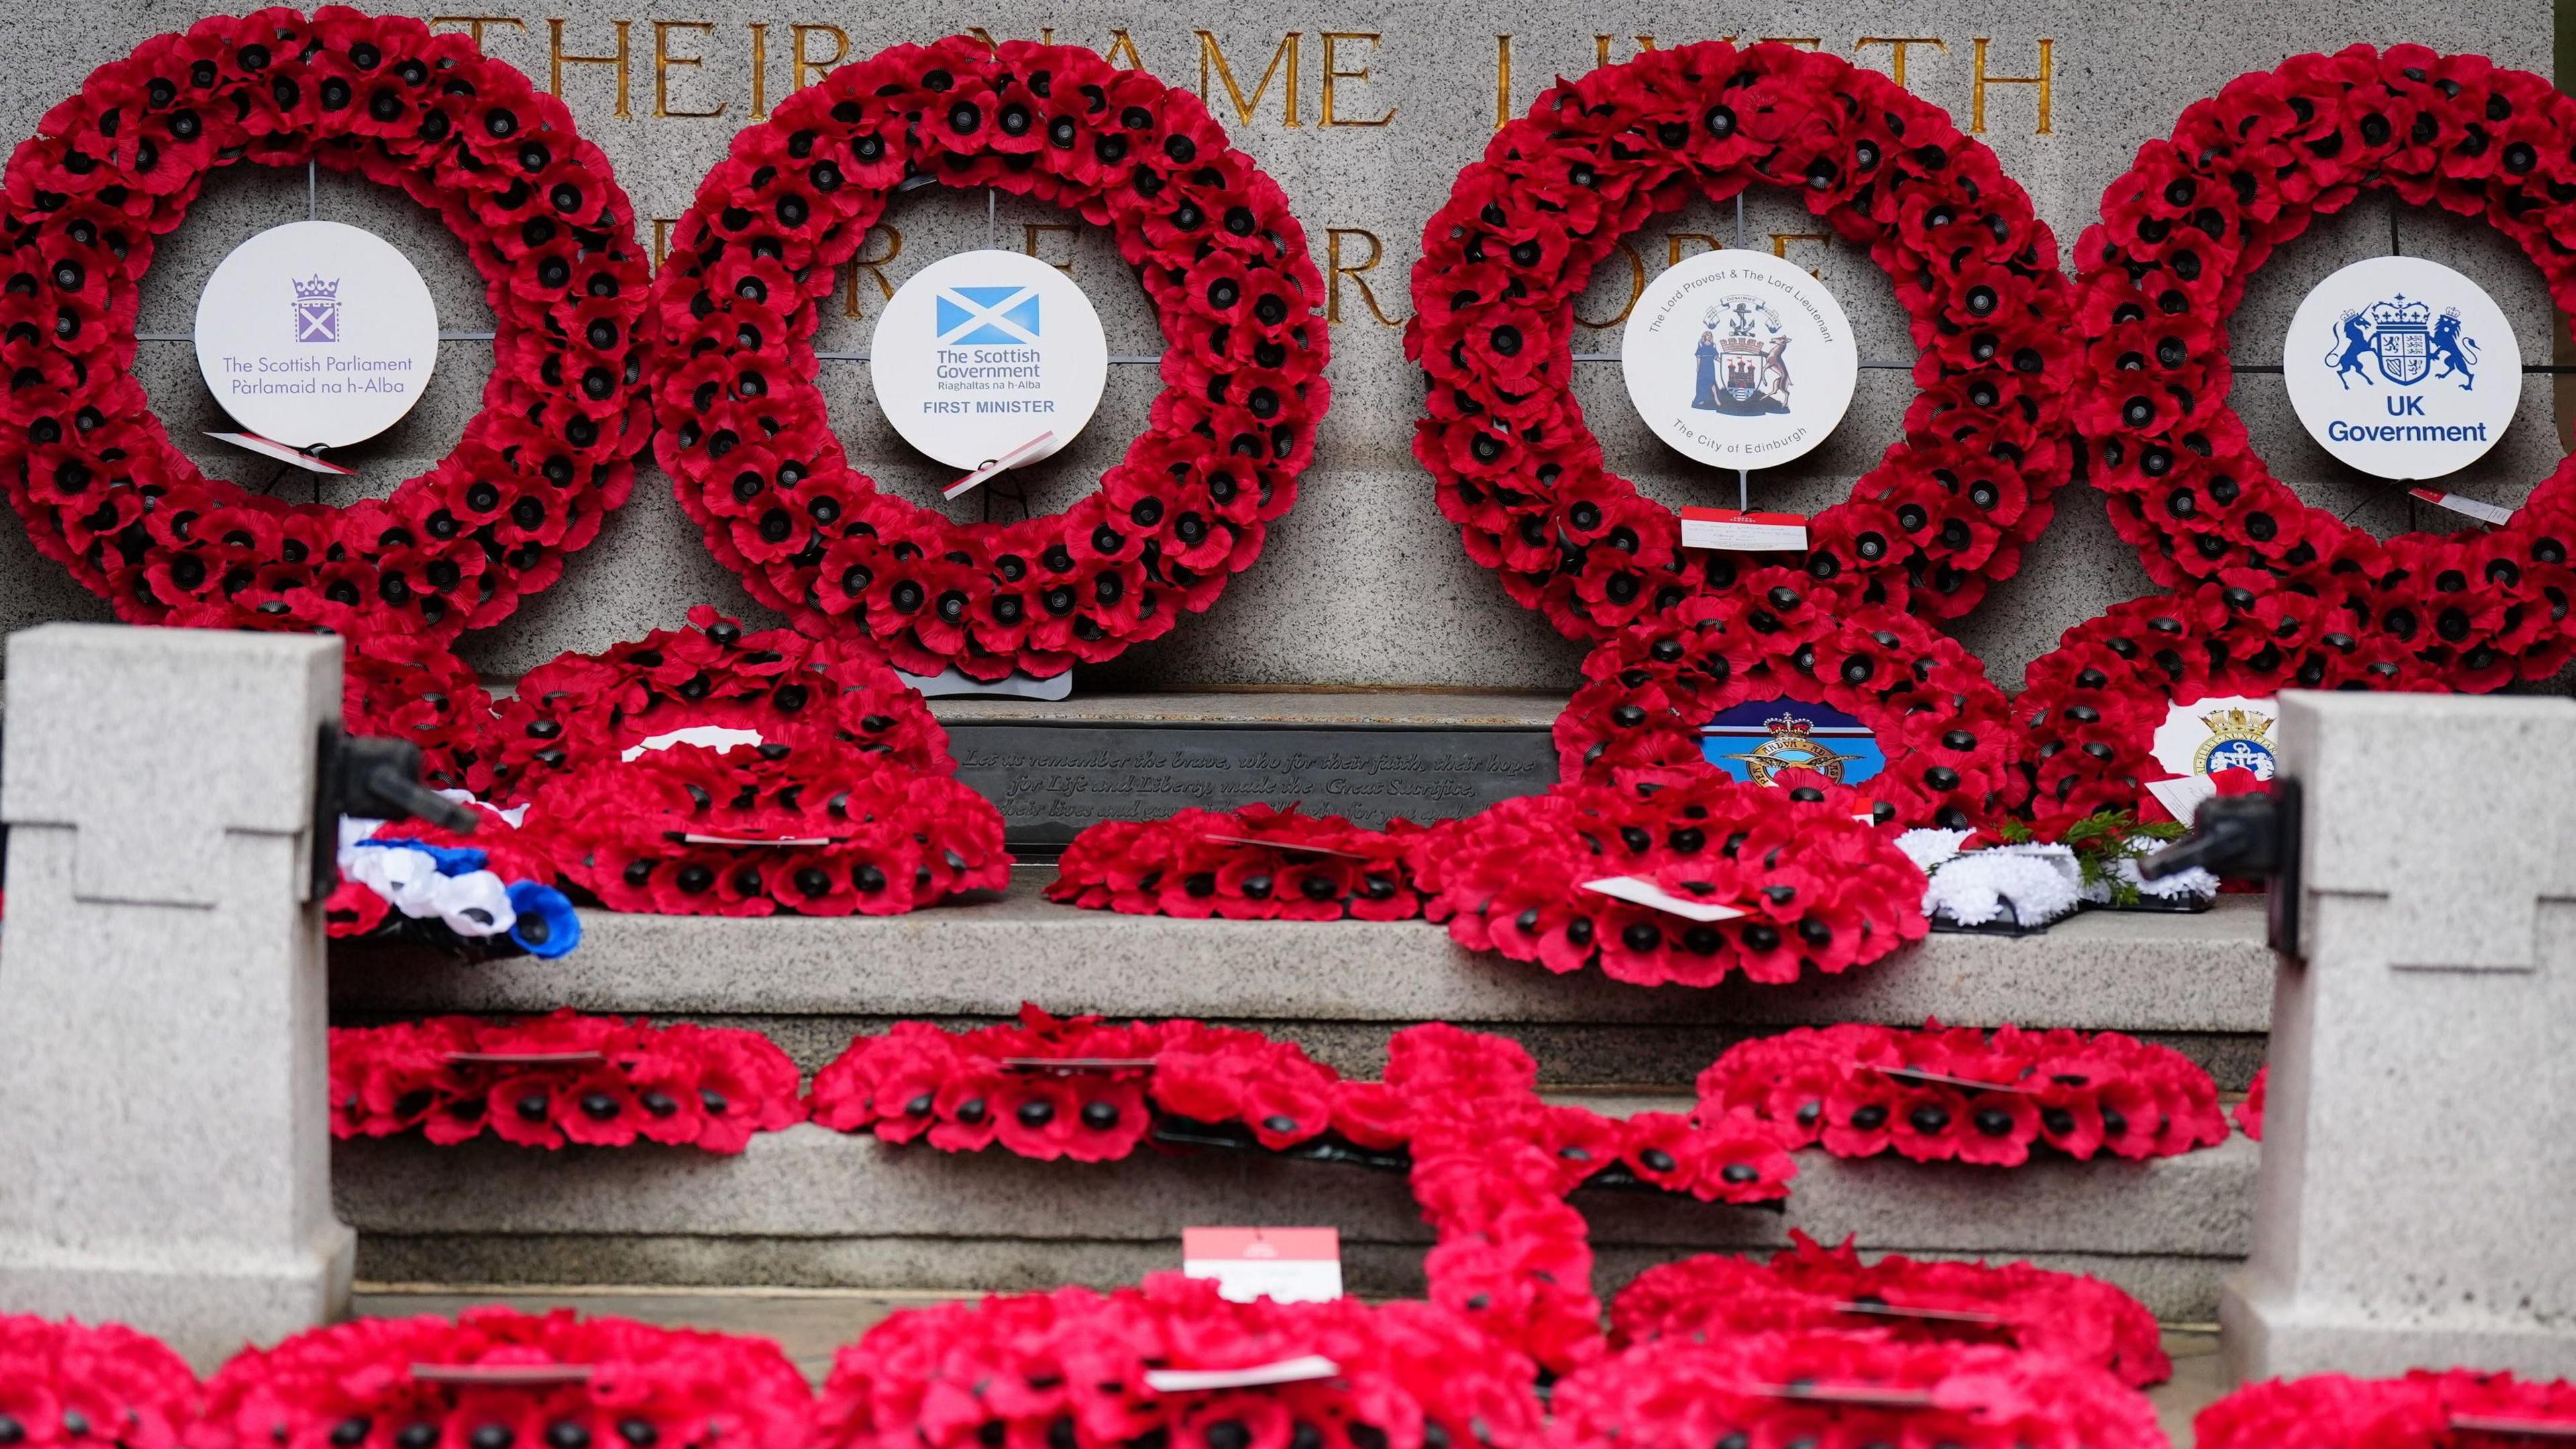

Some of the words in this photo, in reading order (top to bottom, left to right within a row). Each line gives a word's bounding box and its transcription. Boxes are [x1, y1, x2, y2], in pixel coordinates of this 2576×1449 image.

[1648, 313, 1666, 334] The
[1662, 290, 1684, 313] Lord
[1682, 270, 1726, 293] Provost
[1730, 269, 1738, 278] &
[1743, 269, 1764, 282] The
[1768, 276, 1793, 294] Lord
[1794, 290, 1833, 343] Lieutenant
[223, 357, 252, 373] The
[258, 356, 321, 372] Scottish
[327, 356, 413, 371] Parliament
[937, 350, 968, 364] The
[974, 349, 1040, 363] Scottish
[936, 364, 1040, 378] Government
[232, 378, 316, 394] Pàrlamaid
[321, 382, 342, 393] na
[347, 378, 405, 393] h-Alba
[938, 381, 990, 391] Riaghaltas
[1008, 380, 1040, 389] h-Alba
[924, 402, 971, 414] FIRST
[976, 400, 1055, 413] MINISTER
[2387, 395, 2425, 416] UK
[1673, 419, 1693, 438] The
[1698, 435, 1722, 452] City
[1727, 443, 1739, 453] of
[1745, 426, 1807, 454] Edinburgh
[2328, 420, 2487, 442] Government
[963, 749, 999, 767] Let
[1002, 754, 1025, 767] us
[1029, 750, 1131, 768] remember
[1134, 750, 1167, 768] the
[1171, 751, 1231, 770] brave,
[1238, 751, 1281, 769] who
[1281, 751, 1316, 774] for
[1321, 753, 1368, 771] their
[1368, 753, 1426, 775] faith,
[1434, 753, 1483, 771] their
[1486, 753, 1535, 777] hope
[1007, 773, 1042, 797] for
[1046, 775, 1088, 797] Life
[1091, 775, 1134, 793] and
[1137, 775, 1213, 798] Liberty,
[1220, 775, 1277, 794] made
[1281, 775, 1313, 794] the
[1326, 778, 1384, 795] Great
[1387, 779, 1476, 800] Sacrifice,
[1049, 800, 1093, 817] lives
